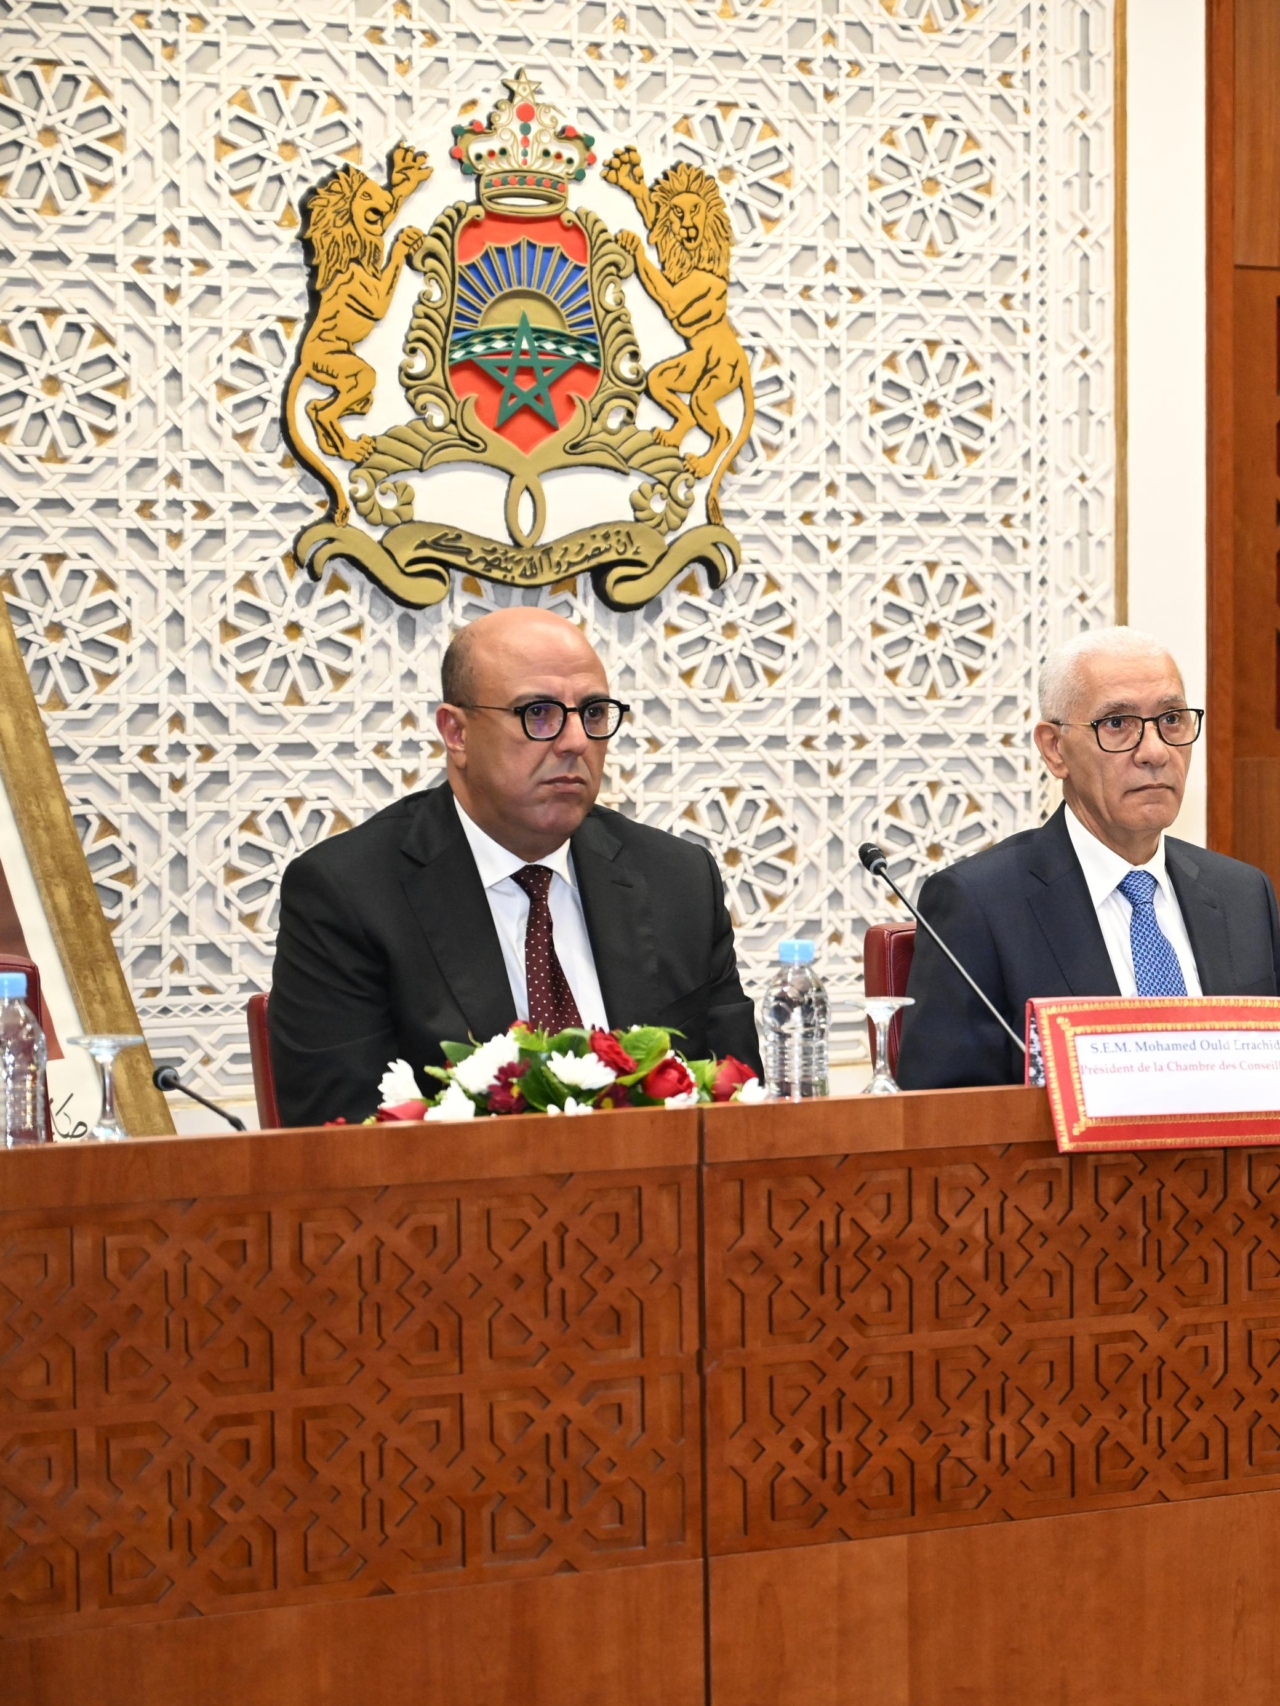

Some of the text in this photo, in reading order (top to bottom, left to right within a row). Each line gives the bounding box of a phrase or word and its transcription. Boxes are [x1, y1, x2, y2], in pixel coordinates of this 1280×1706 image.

[1090, 1039, 1280, 1054] S.E.M. Mohamed Ould Errachid
[1080, 1063, 1134, 1075] Président
[1137, 1061, 1151, 1073] de
[1153, 1061, 1164, 1073] la
[1166, 1060, 1216, 1072] Chambre
[1218, 1059, 1237, 1071] des
